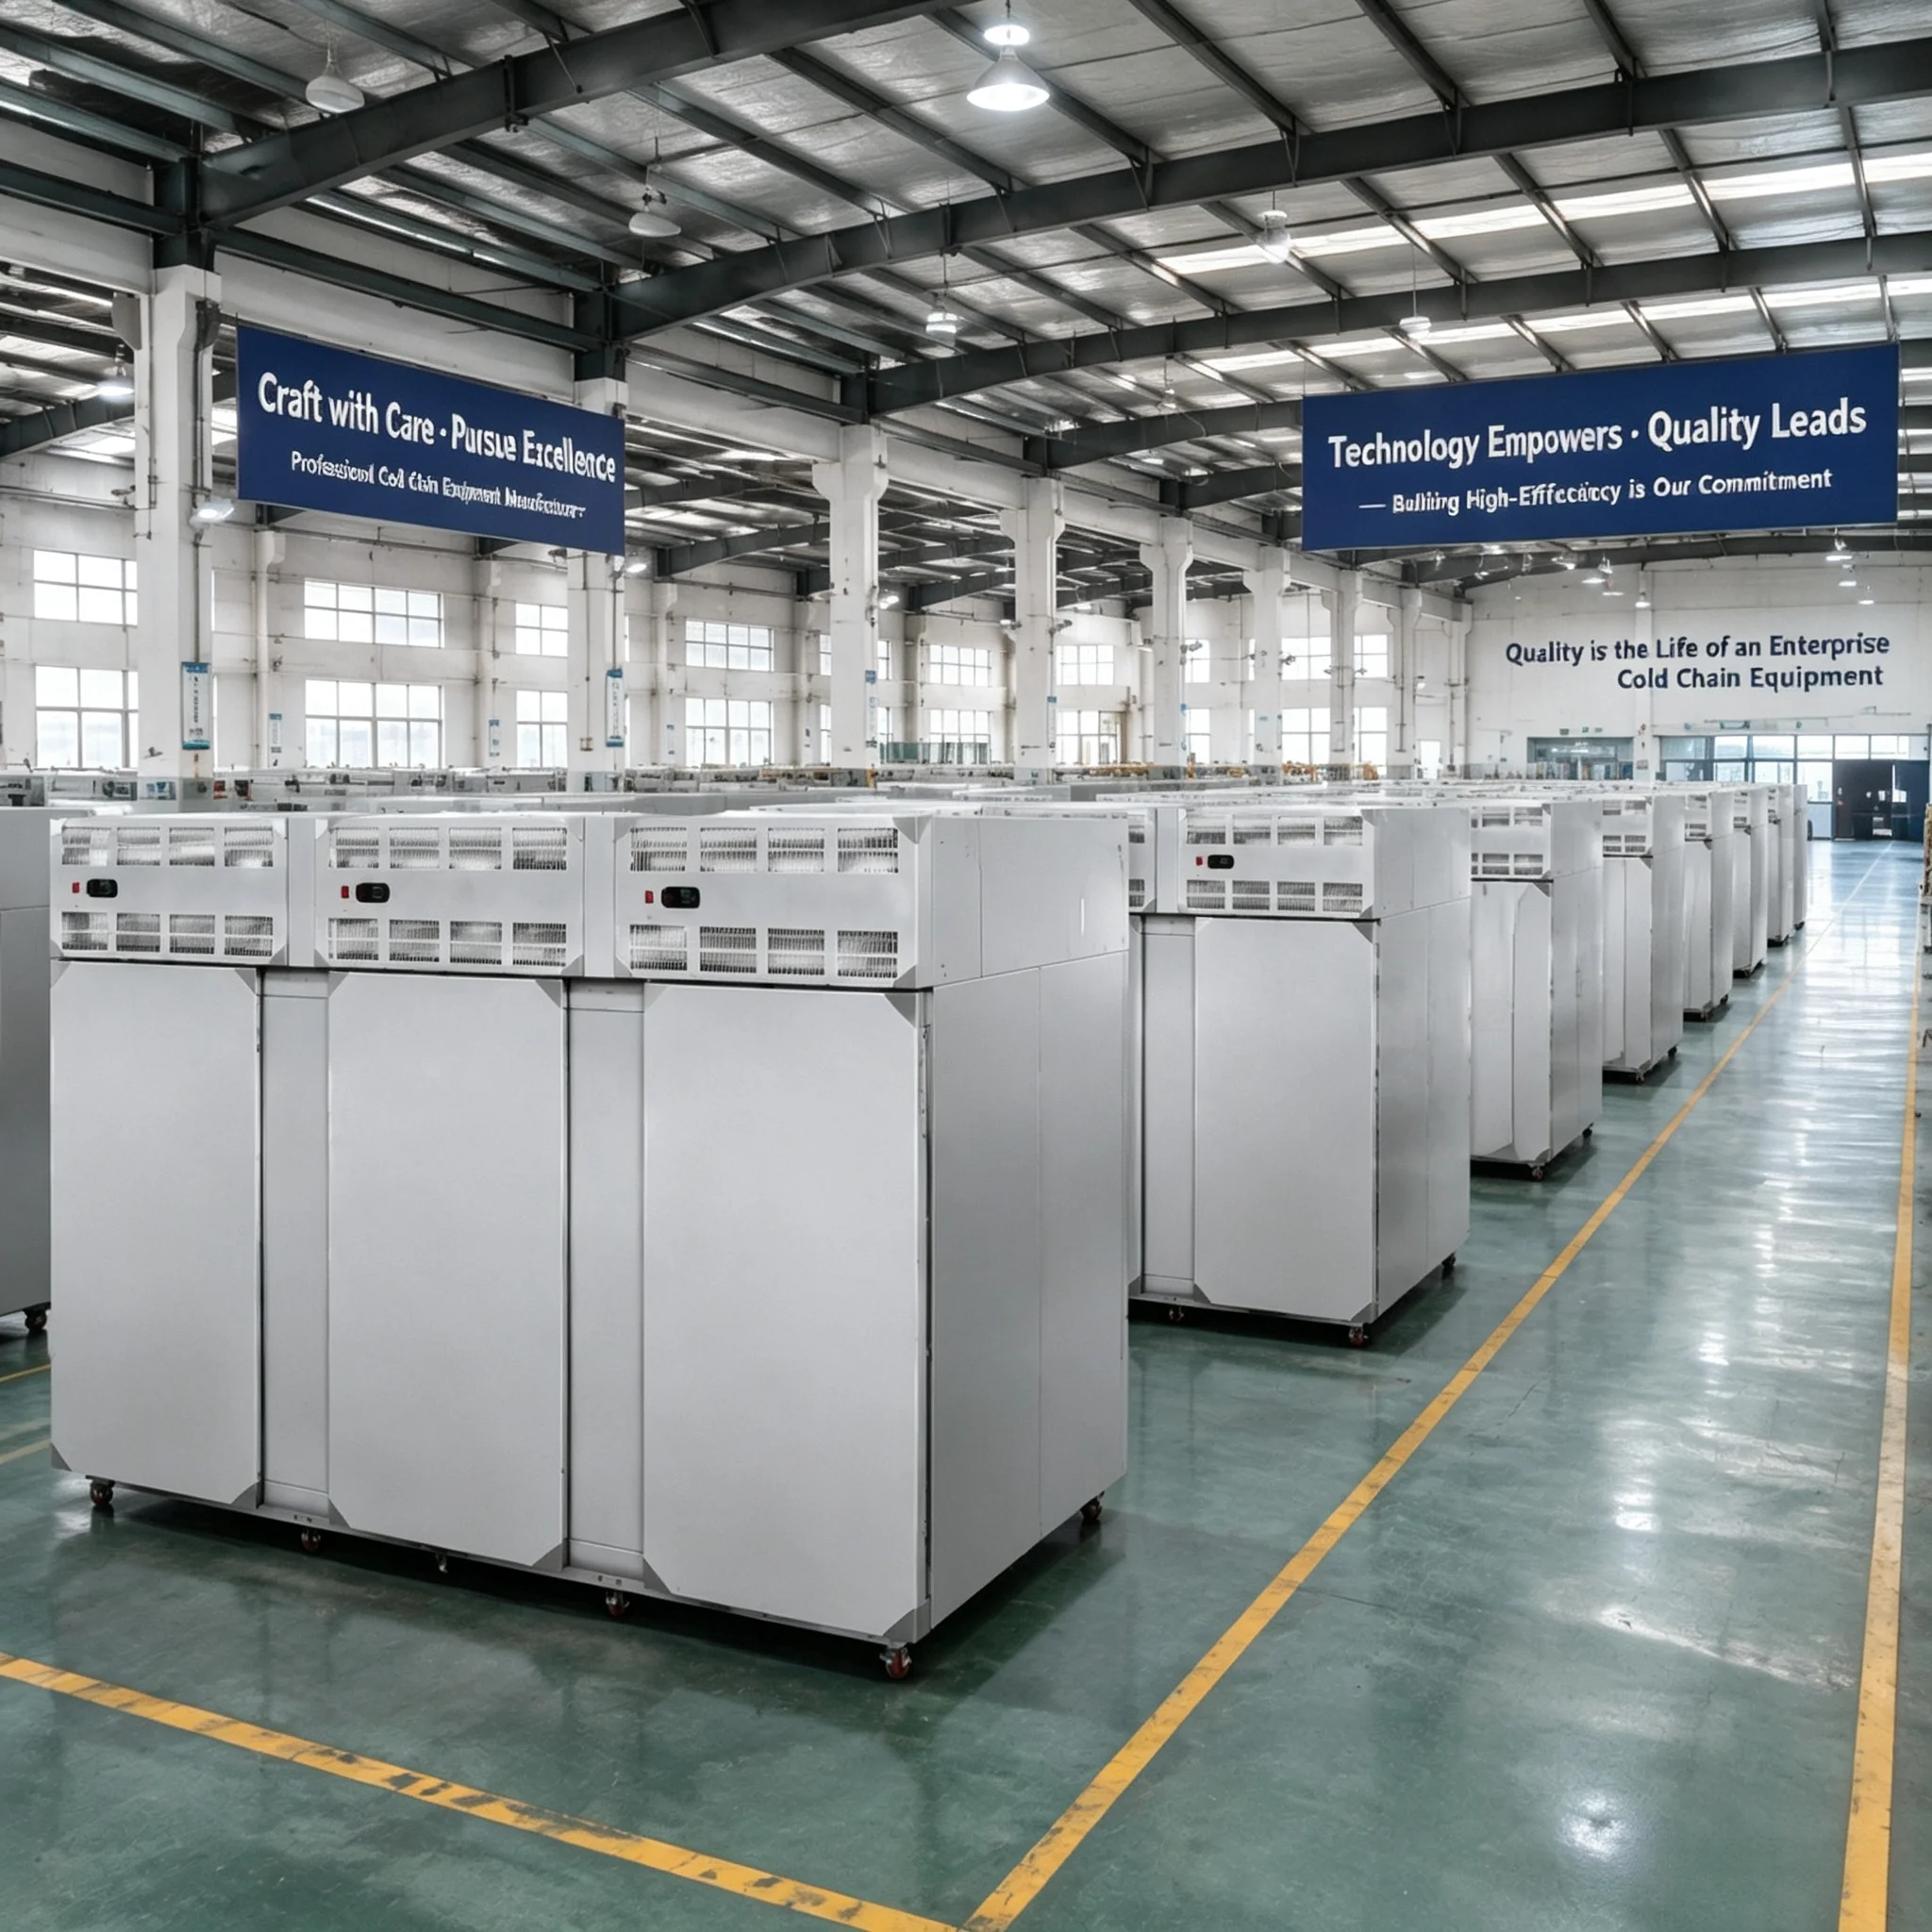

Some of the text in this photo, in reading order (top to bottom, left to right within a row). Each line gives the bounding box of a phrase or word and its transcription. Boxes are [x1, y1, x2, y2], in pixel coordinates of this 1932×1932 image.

[258, 373, 323, 422] Craft
[328, 391, 378, 434] with
[386, 402, 434, 444] Care
[1328, 429, 1479, 469] Technology
[1489, 425, 1623, 463] Empowers
[1649, 407, 1760, 451] Quality
[1773, 397, 1866, 438] Leads
[1629, 479, 1645, 498] is
[1654, 477, 1691, 496] Our
[1699, 469, 1832, 493] Commitment
[1506, 632, 1890, 666] Quality is the Life of an Enterprise
[1618, 666, 1883, 692] Cold Chain Equipment
